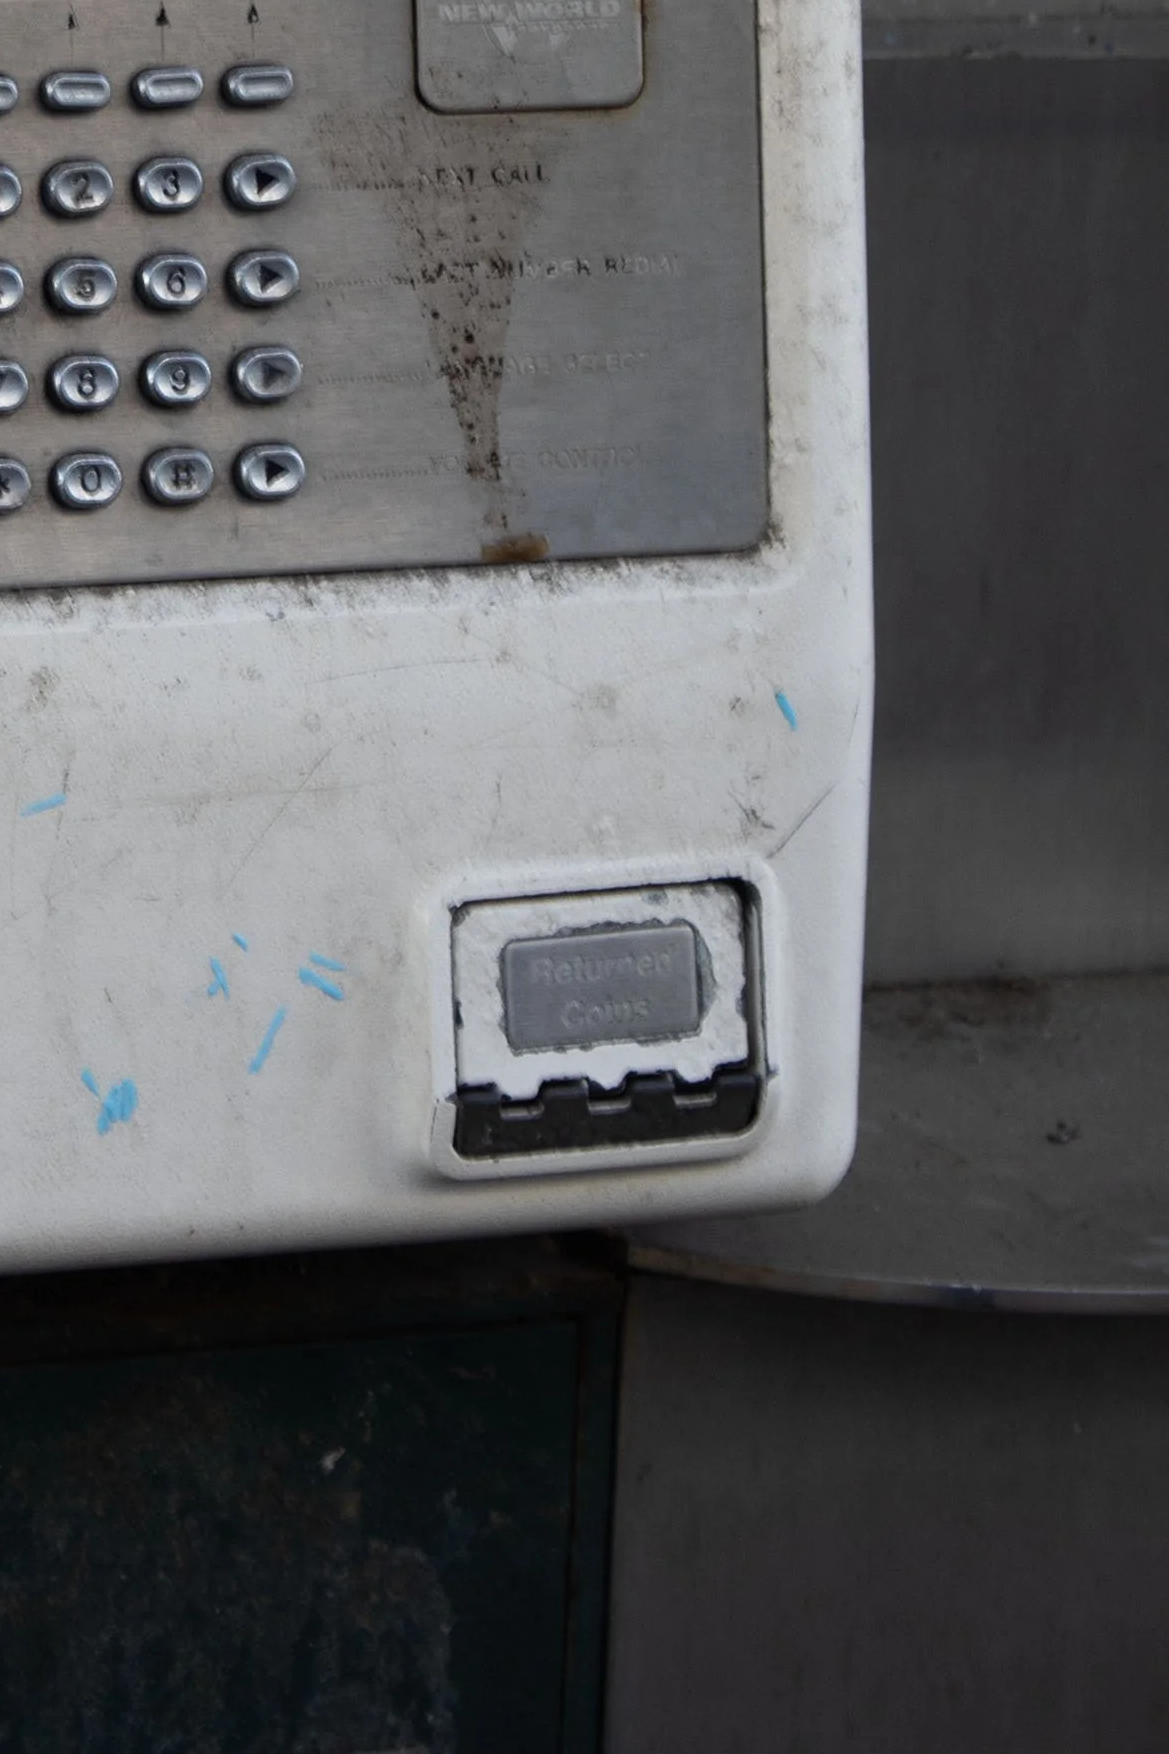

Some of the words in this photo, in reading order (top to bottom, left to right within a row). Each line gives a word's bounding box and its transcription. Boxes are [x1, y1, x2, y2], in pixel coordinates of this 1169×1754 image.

[437, 2, 509, 22] NEW
[75, 171, 94, 200] 2
[162, 169, 180, 198] 3
[75, 268, 97, 301] 5
[166, 266, 187, 297] 6
[78, 366, 97, 398] 8
[171, 365, 190, 395] 9
